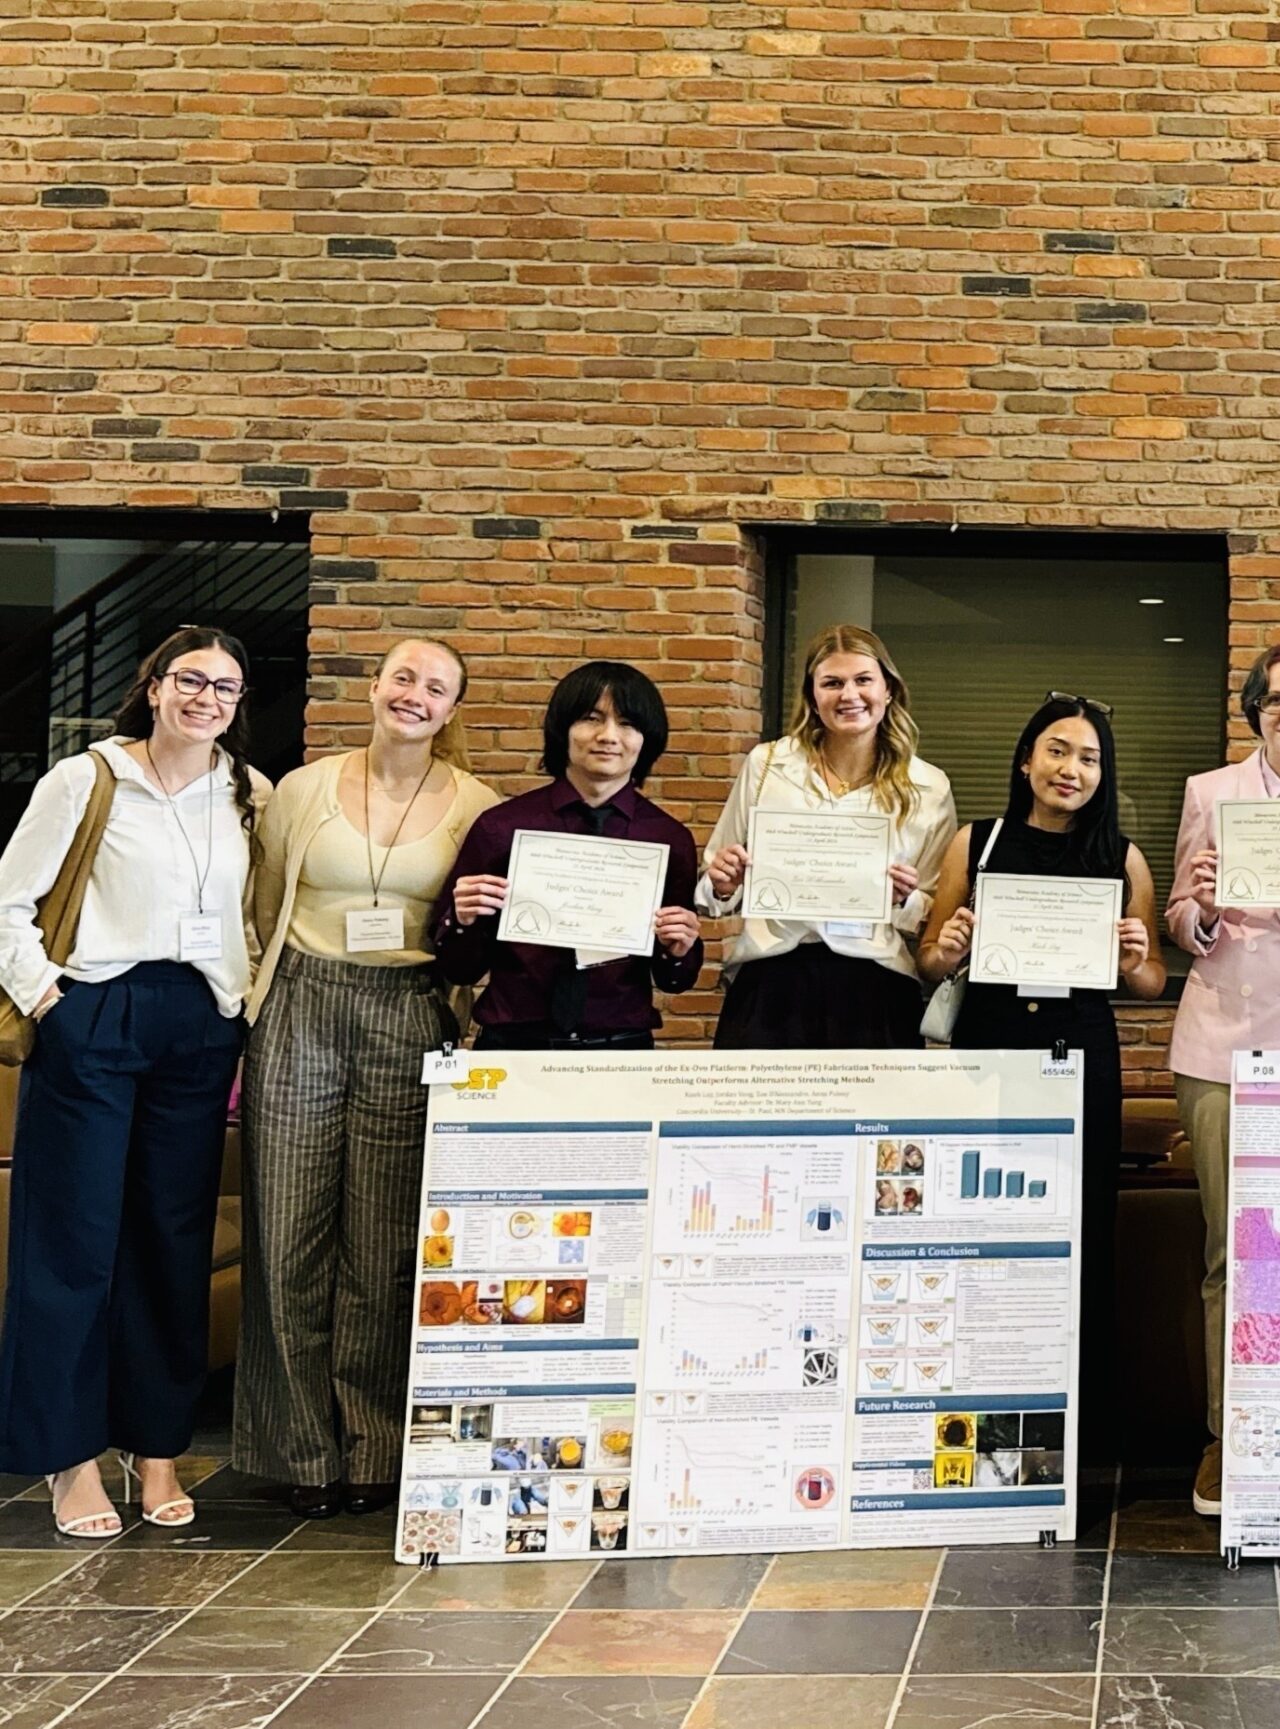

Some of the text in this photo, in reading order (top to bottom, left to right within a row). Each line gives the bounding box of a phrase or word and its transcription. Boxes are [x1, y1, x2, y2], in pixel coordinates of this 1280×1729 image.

[835, 860, 857, 868] Award
[600, 887, 624, 898] Award
[1063, 926, 1083, 935] Award
[436, 1060, 458, 1070] P 01
[541, 1065, 584, 1074] Advancing
[586, 1065, 653, 1074] Standardization
[655, 1065, 664, 1074] of
[665, 1065, 678, 1073] the
[750, 1064, 802, 1073] Polyethylene
[824, 1064, 870, 1073] Fabrication
[871, 1064, 916, 1072] Techniques
[917, 1064, 948, 1072] Suggest
[950, 1064, 980, 1072] Vacuum
[1042, 1068, 1076, 1077] 455/456
[1253, 1066, 1274, 1075] P 08
[652, 1076, 875, 1086] Stretching Outperforms Alternative Stretching Methods
[456, 1092, 496, 1100] SCIENCE
[434, 1124, 468, 1133] Abstract
[855, 1122, 889, 1134] Results
[428, 1192, 543, 1200] Introduction and Motivation
[866, 1246, 979, 1258] Discussion & Conclusion
[418, 1342, 504, 1352] Hypothesis and Aims
[414, 1387, 507, 1396] Materials and Methods
[858, 1400, 936, 1411] Future Research
[852, 1498, 905, 1509] References
